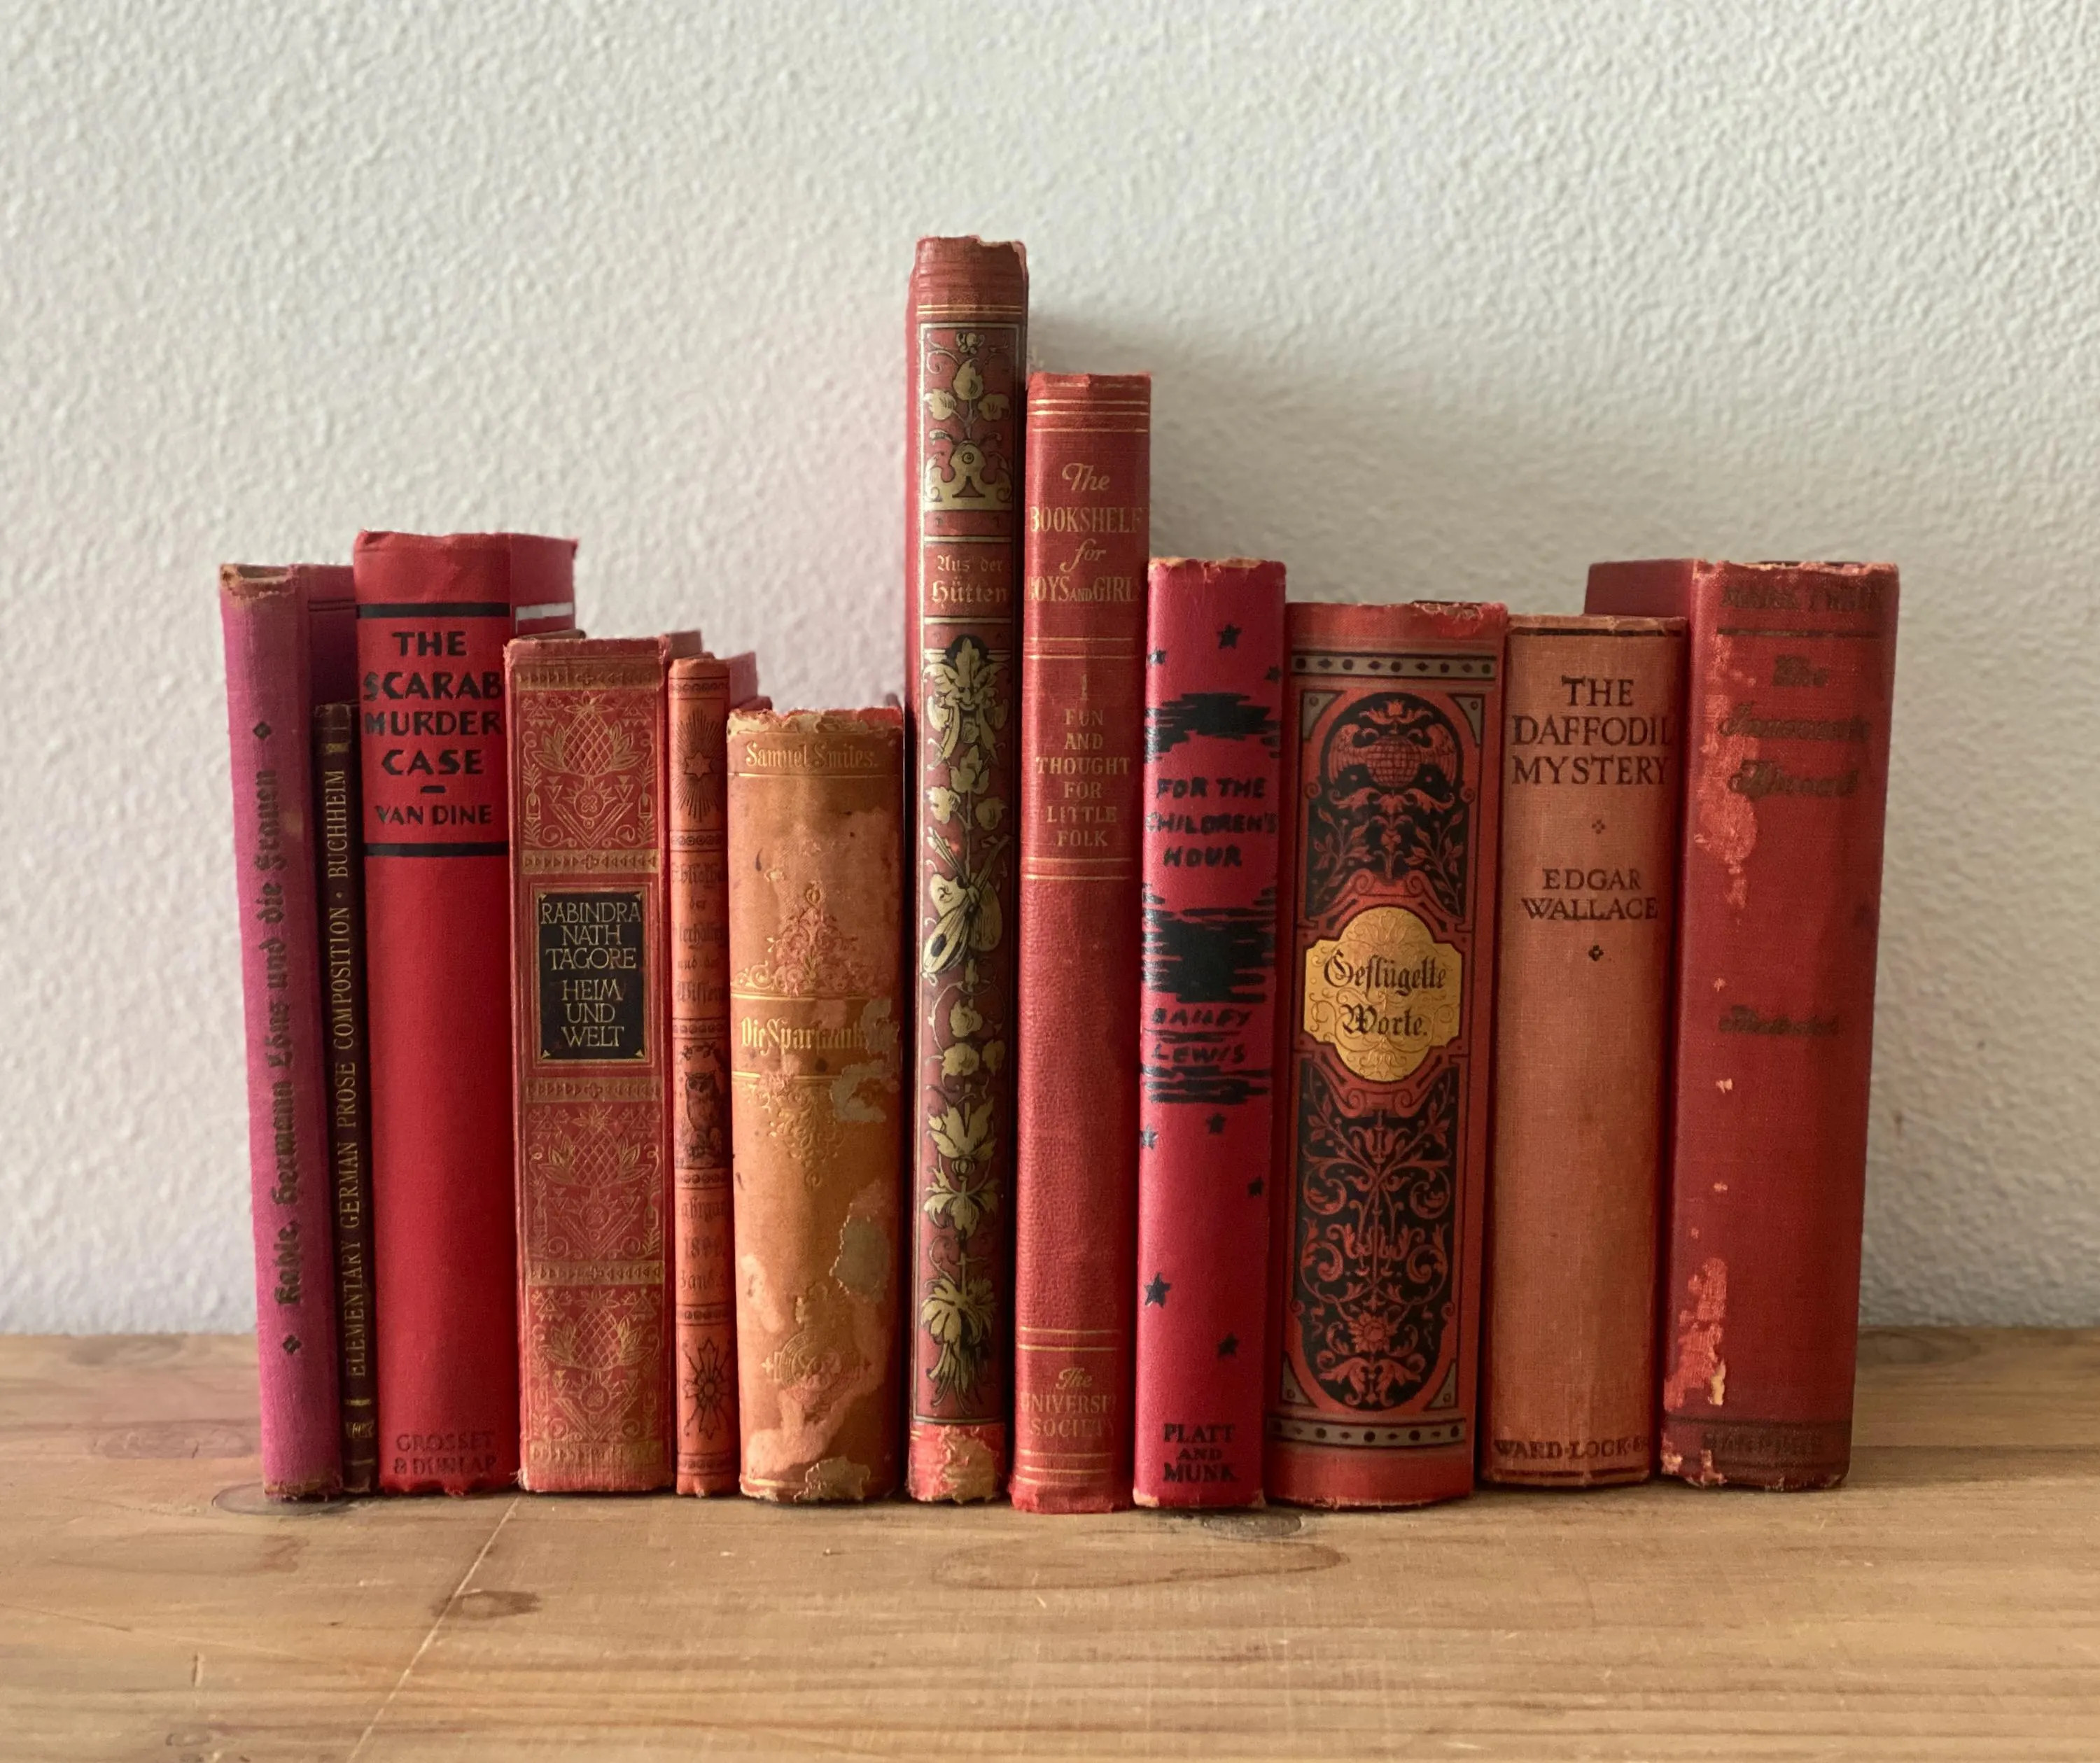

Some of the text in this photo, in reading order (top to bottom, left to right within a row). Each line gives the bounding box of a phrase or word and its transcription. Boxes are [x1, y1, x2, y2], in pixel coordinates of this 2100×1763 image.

[1062, 463, 1111, 491] The
[937, 554, 1003, 573] Aus der
[1060, 538, 1107, 573] for
[931, 576, 1007, 609] Hütten
[392, 631, 468, 656] THE
[363, 671, 503, 701] SCARAB
[1561, 675, 1634, 707] THE
[363, 711, 504, 736] MURDER
[1065, 708, 1104, 726] FUN
[1064, 733, 1103, 750] AND
[1512, 715, 1672, 746] DAFFODIL
[382, 749, 484, 776] CASE
[746, 740, 808, 768] Samuel
[1035, 757, 1130, 775] THOUGHT
[1511, 754, 1669, 785] MYSTERY
[1064, 781, 1102, 799] FOR
[1156, 777, 1266, 799] FOR THE
[255, 770, 288, 871] Frauen
[374, 805, 493, 825] VAN DINE
[1046, 806, 1118, 822] LITTLE
[1057, 830, 1108, 848] FOLK
[1163, 844, 1242, 867] HOUR
[1542, 868, 1643, 891] EDGAR
[256, 883, 284, 924] die
[540, 901, 641, 925] RABINDRA
[1521, 897, 1658, 922] WALLACE
[562, 924, 622, 946] NATH
[259, 936, 288, 989] und
[545, 947, 637, 971] TAGORE
[1324, 948, 1447, 997] Geflügelte
[561, 978, 624, 1001] HEIM
[565, 1002, 616, 1024] UND
[1338, 1003, 1428, 1037] Worte.
[561, 1026, 624, 1048] WELT
[741, 1016, 765, 1048] Die
[1151, 1044, 1247, 1065] LEWIS
[325, 770, 366, 1377] ELEMENTARY GERMAN PROSE COMPOSITION BUCHHEIM
[1056, 1367, 1093, 1390] The
[1163, 1424, 1236, 1442] PLATT
[1177, 1448, 1223, 1461] AND
[1163, 1462, 1240, 1483] MUNK
